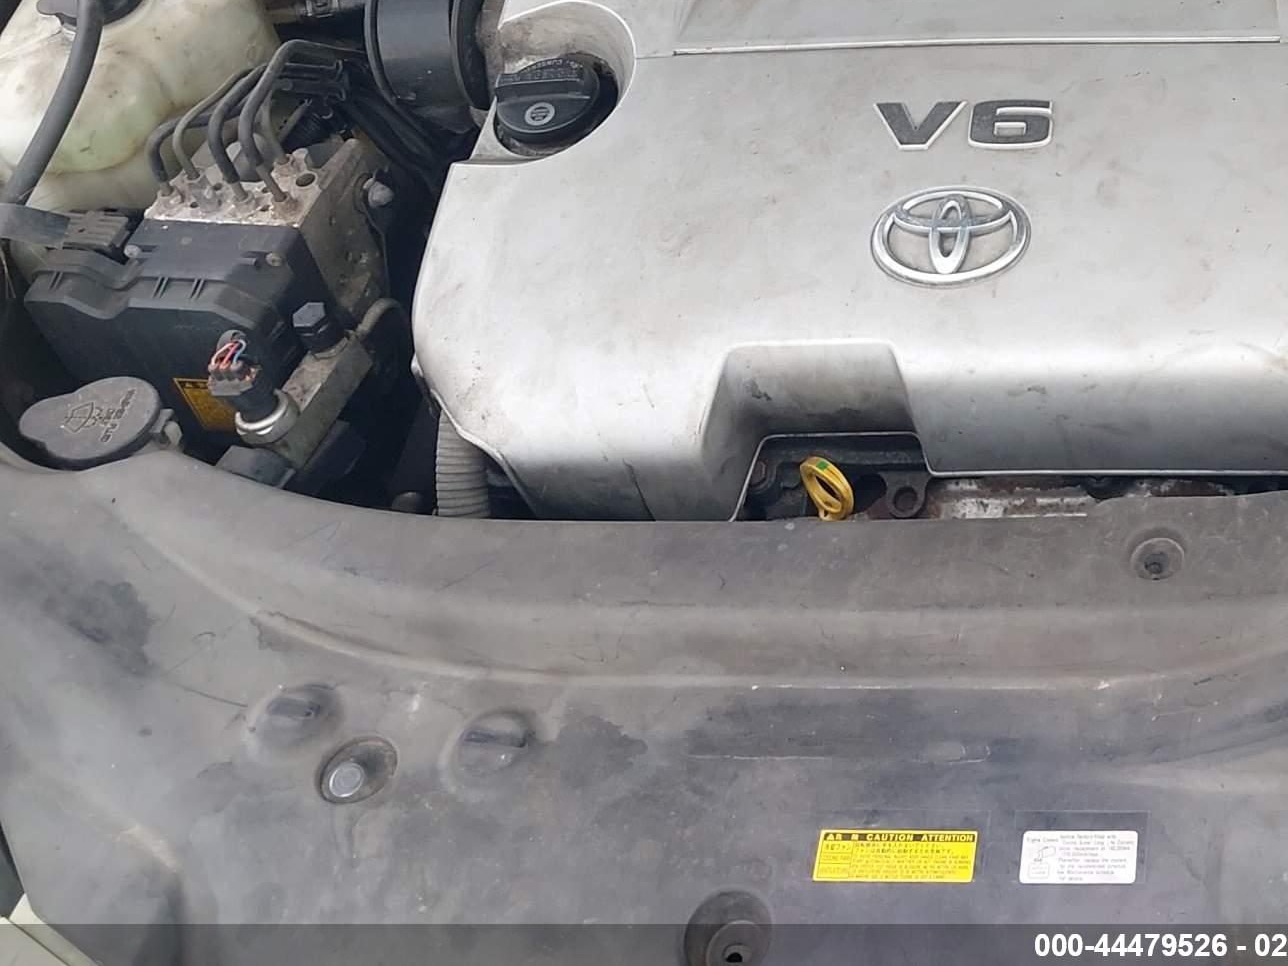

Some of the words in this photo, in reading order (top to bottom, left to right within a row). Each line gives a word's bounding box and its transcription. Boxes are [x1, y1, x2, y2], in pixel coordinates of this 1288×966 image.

[873, 98, 1054, 151] V6
[866, 833, 913, 842] CAUTION
[920, 833, 973, 842] ATTENTION
